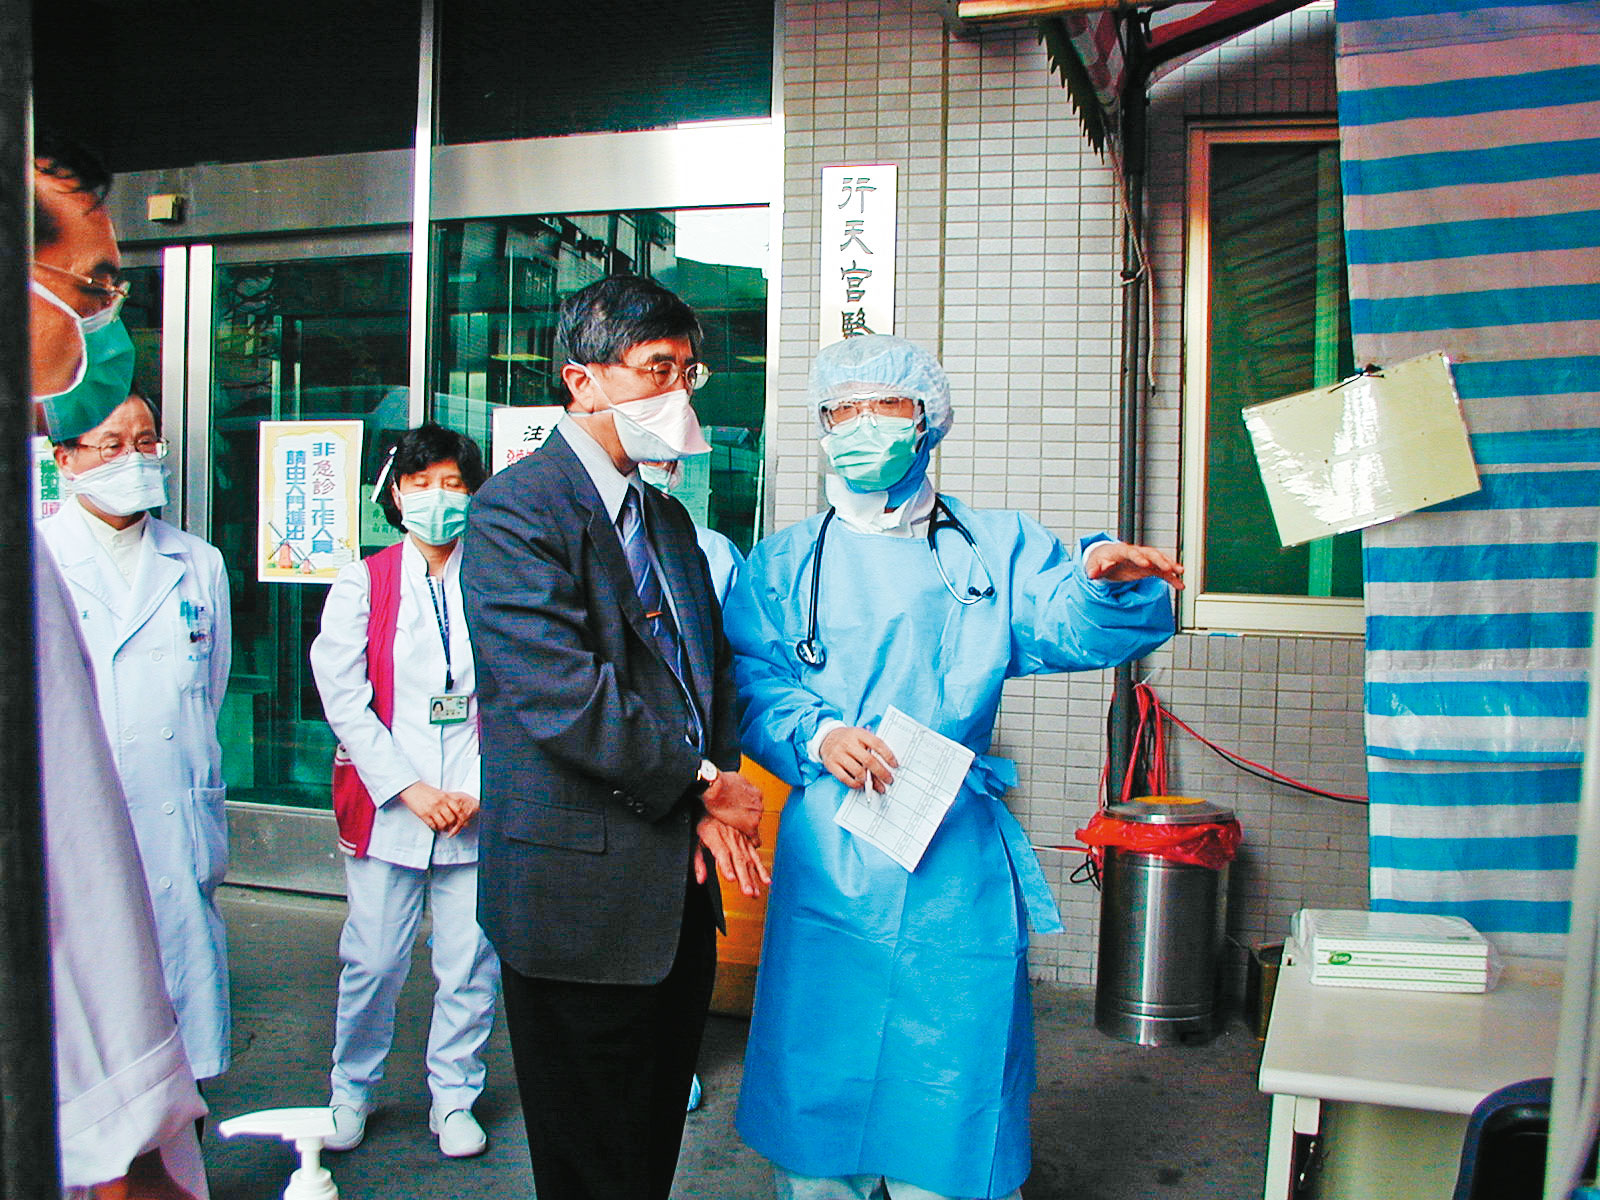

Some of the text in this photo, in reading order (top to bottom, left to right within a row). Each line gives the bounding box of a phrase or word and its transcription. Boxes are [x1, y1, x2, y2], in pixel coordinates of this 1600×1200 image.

[523, 425, 553, 442] 注
[285, 450, 306, 541] 請由大門進出
[312, 442, 336, 554] 非急診工作人員
